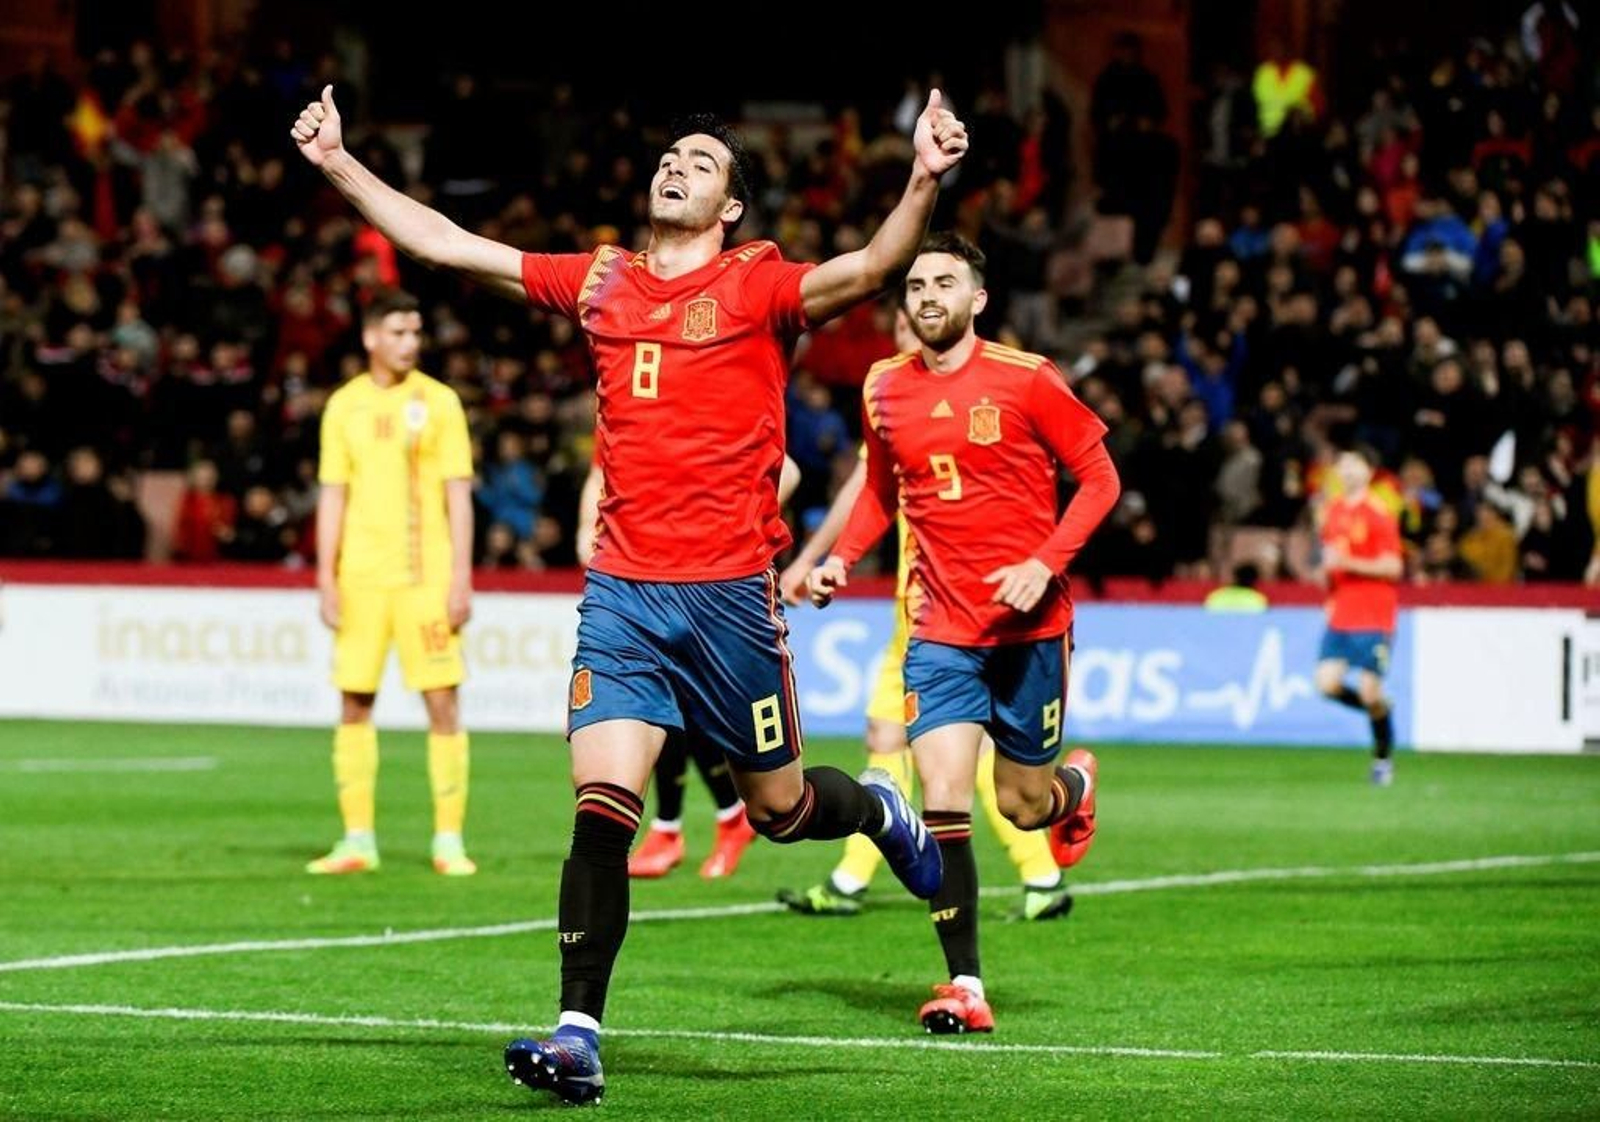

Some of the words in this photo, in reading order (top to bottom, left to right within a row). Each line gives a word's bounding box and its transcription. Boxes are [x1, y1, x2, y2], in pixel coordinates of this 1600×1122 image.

[631, 341, 662, 399] 8
[929, 454, 962, 500] 9
[96, 604, 311, 666] inacua
[751, 693, 785, 754] 8
[1042, 697, 1062, 750] 9
